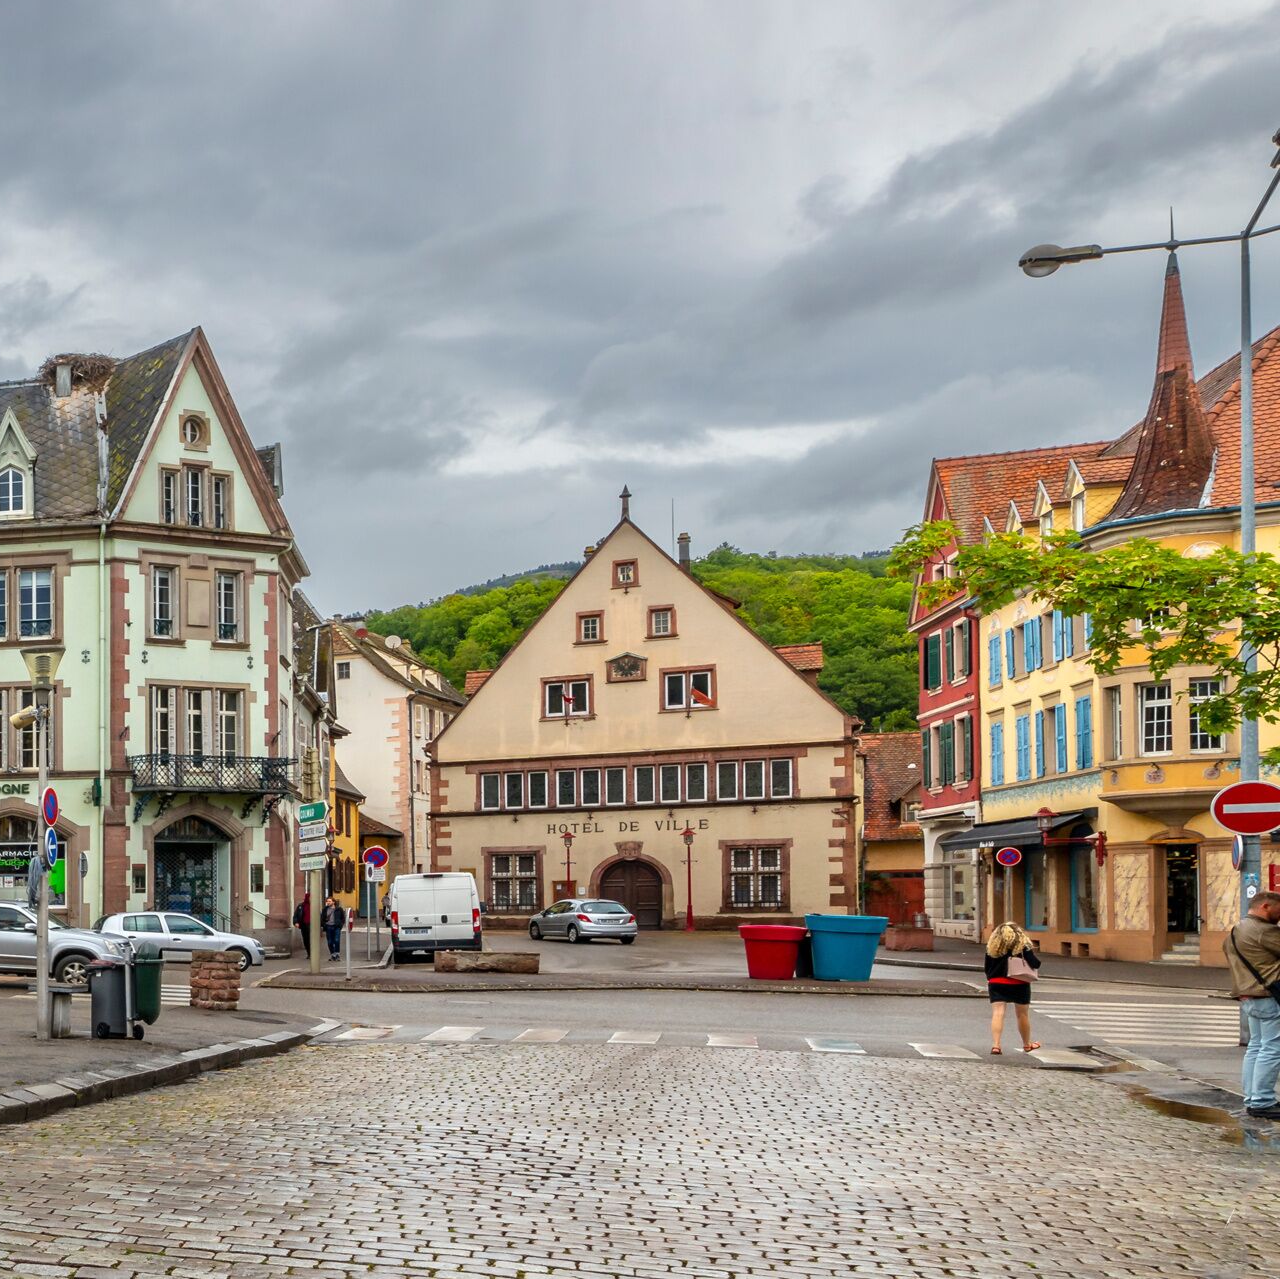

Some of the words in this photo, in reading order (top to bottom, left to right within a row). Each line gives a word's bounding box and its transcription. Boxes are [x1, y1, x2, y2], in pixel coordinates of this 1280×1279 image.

[547, 822, 604, 834] HOTEL
[619, 821, 640, 832] DE
[654, 819, 709, 831] VILLE
